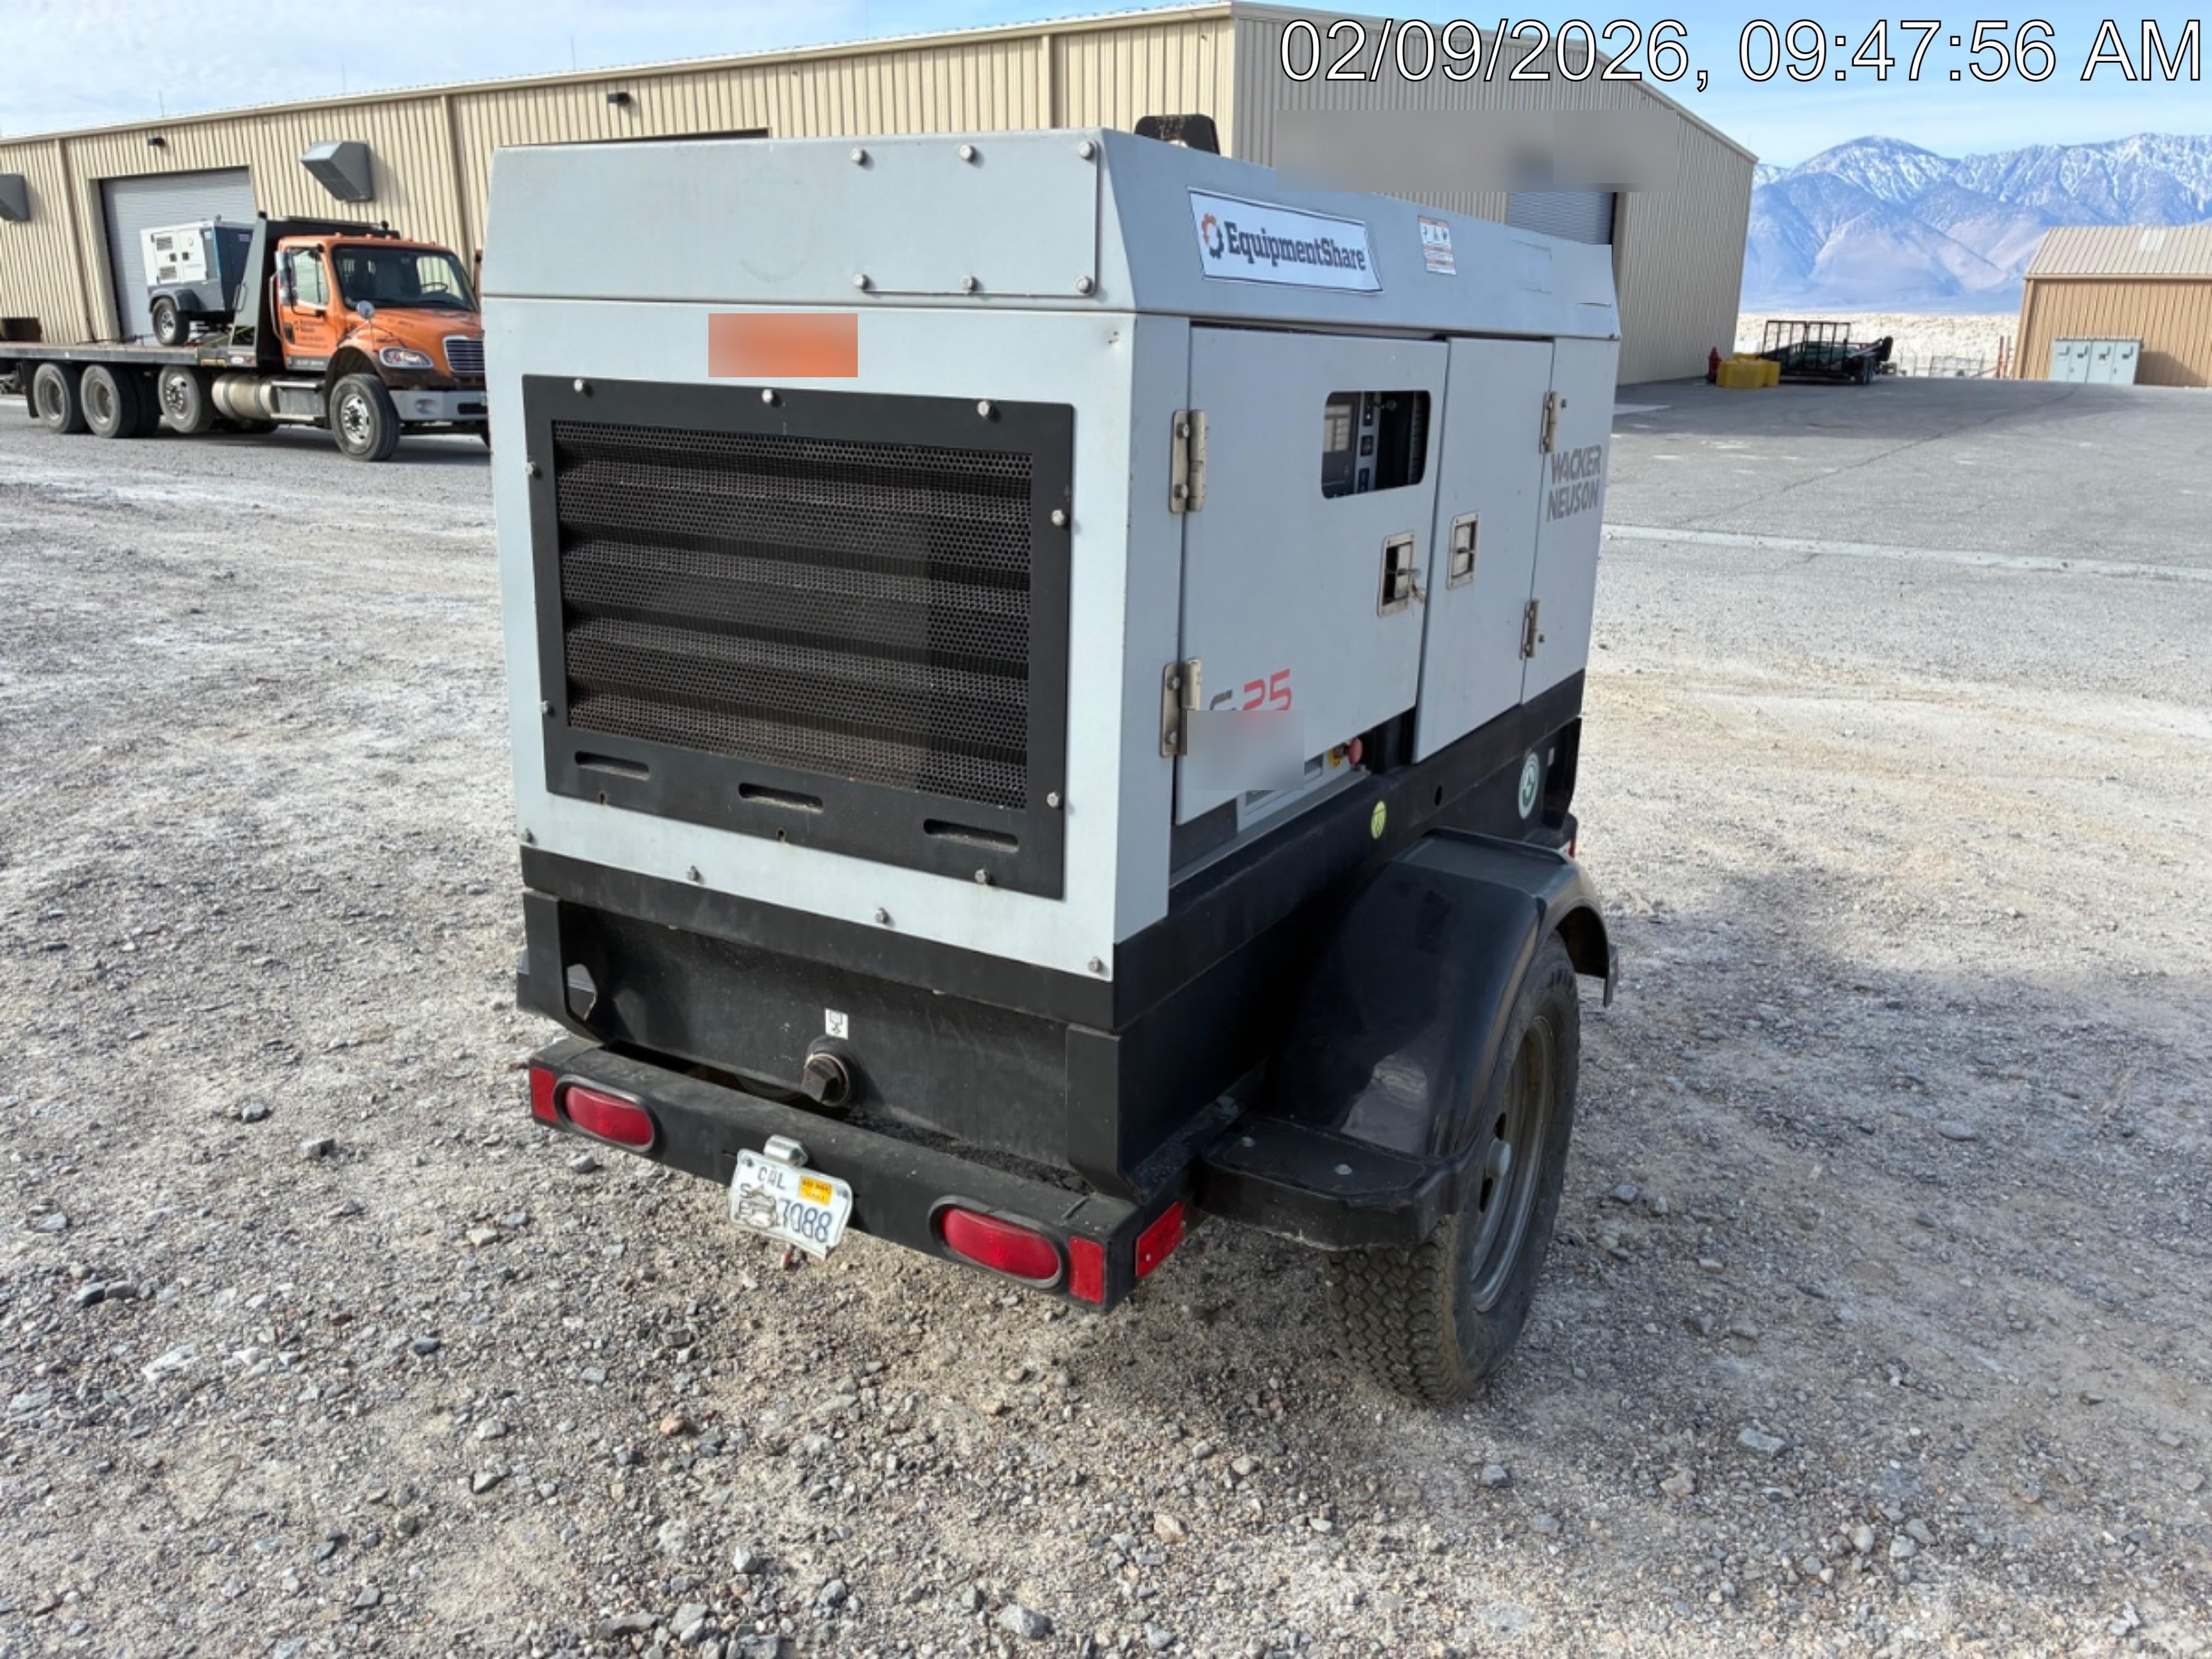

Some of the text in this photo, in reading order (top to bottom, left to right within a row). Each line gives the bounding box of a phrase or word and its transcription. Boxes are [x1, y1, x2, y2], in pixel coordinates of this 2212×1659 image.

[1224, 220, 1367, 271] EquipmentShare
[1551, 445, 1602, 484] WACKER
[1546, 479, 1601, 522] NEUSON
